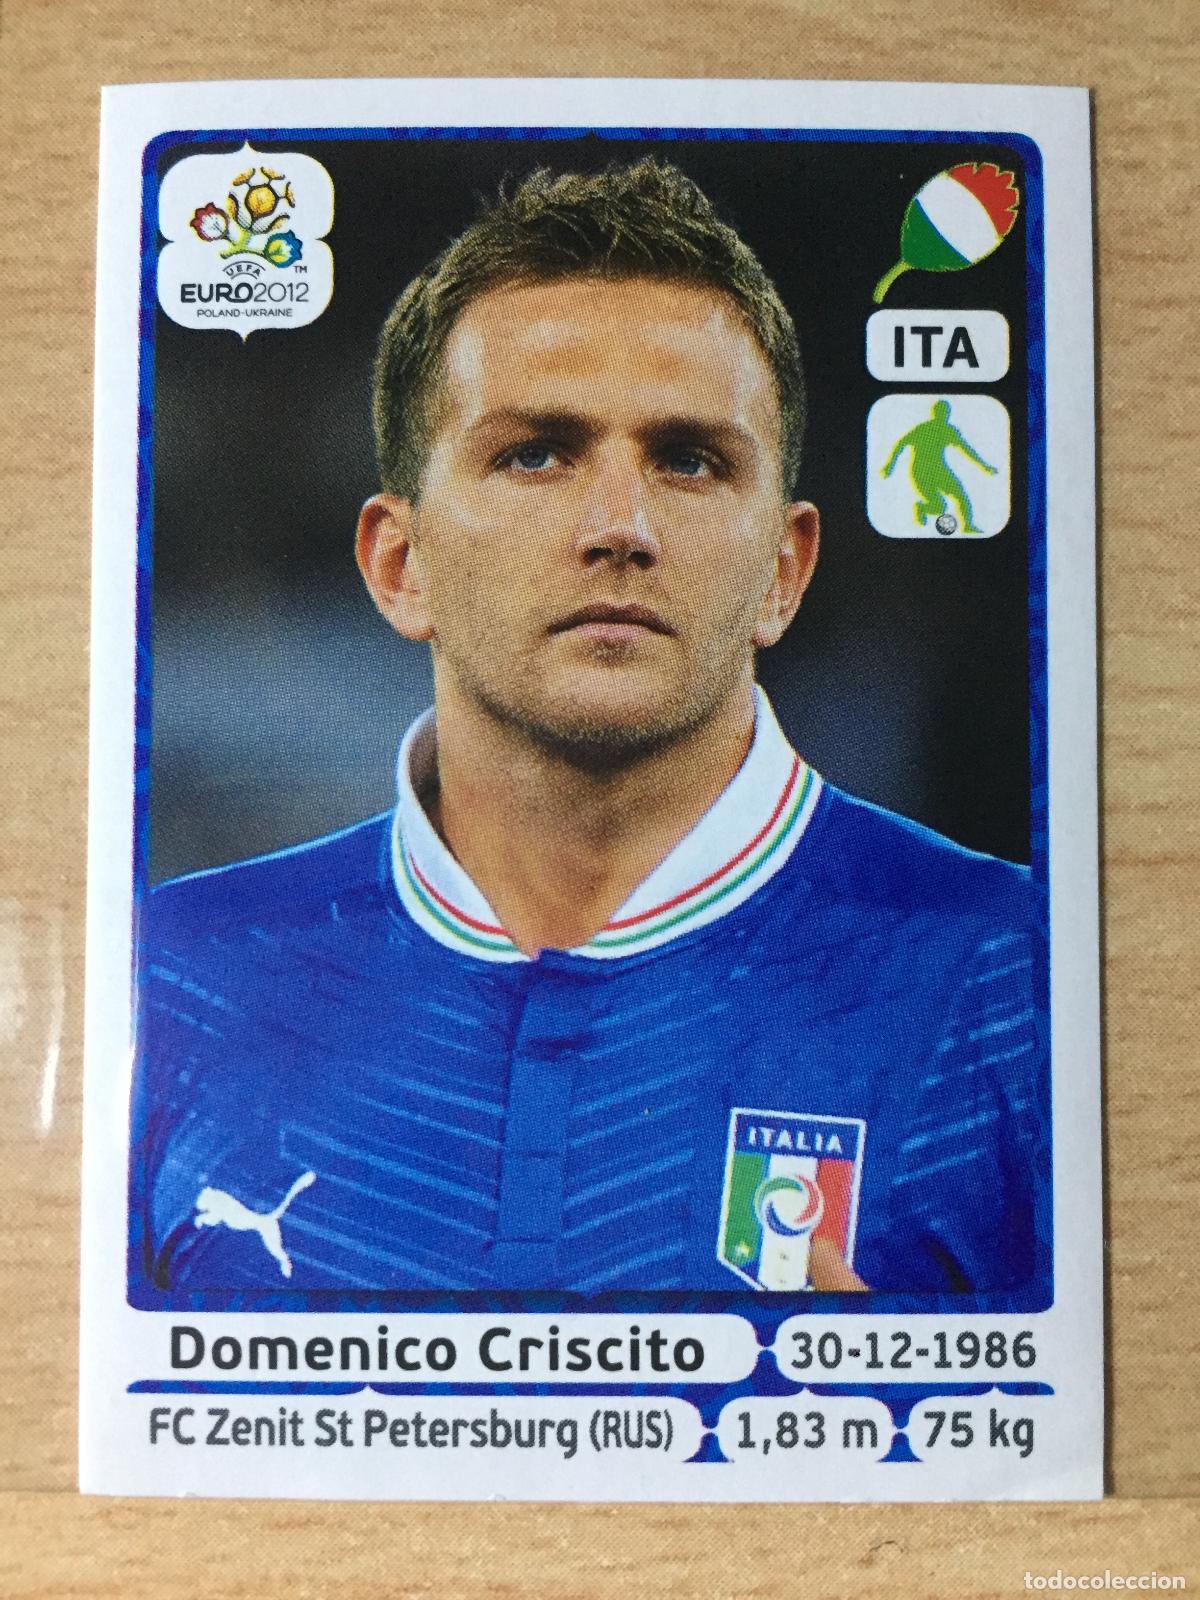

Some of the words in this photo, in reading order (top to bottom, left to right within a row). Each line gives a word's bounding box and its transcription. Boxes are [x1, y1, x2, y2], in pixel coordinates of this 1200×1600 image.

[225, 264, 262, 277] UEFA
[180, 282, 310, 304] EURO2012
[196, 308, 293, 318] POLAND-UKRAINE
[893, 325, 980, 369] ITA
[748, 1126, 843, 1154] ITALIA
[170, 1325, 457, 1371] Domenico
[478, 1325, 705, 1372] Criscito
[791, 1331, 1037, 1369] 30-12-1986
[149, 1407, 196, 1446] FC
[206, 1407, 305, 1447] Zenit
[314, 1408, 354, 1447] St
[364, 1408, 578, 1459] Petersburg
[589, 1409, 674, 1452] (RUS)
[737, 1411, 827, 1455] 1,83
[842, 1417, 879, 1449] m
[923, 1411, 974, 1449] 75
[989, 1408, 1034, 1458] kg
